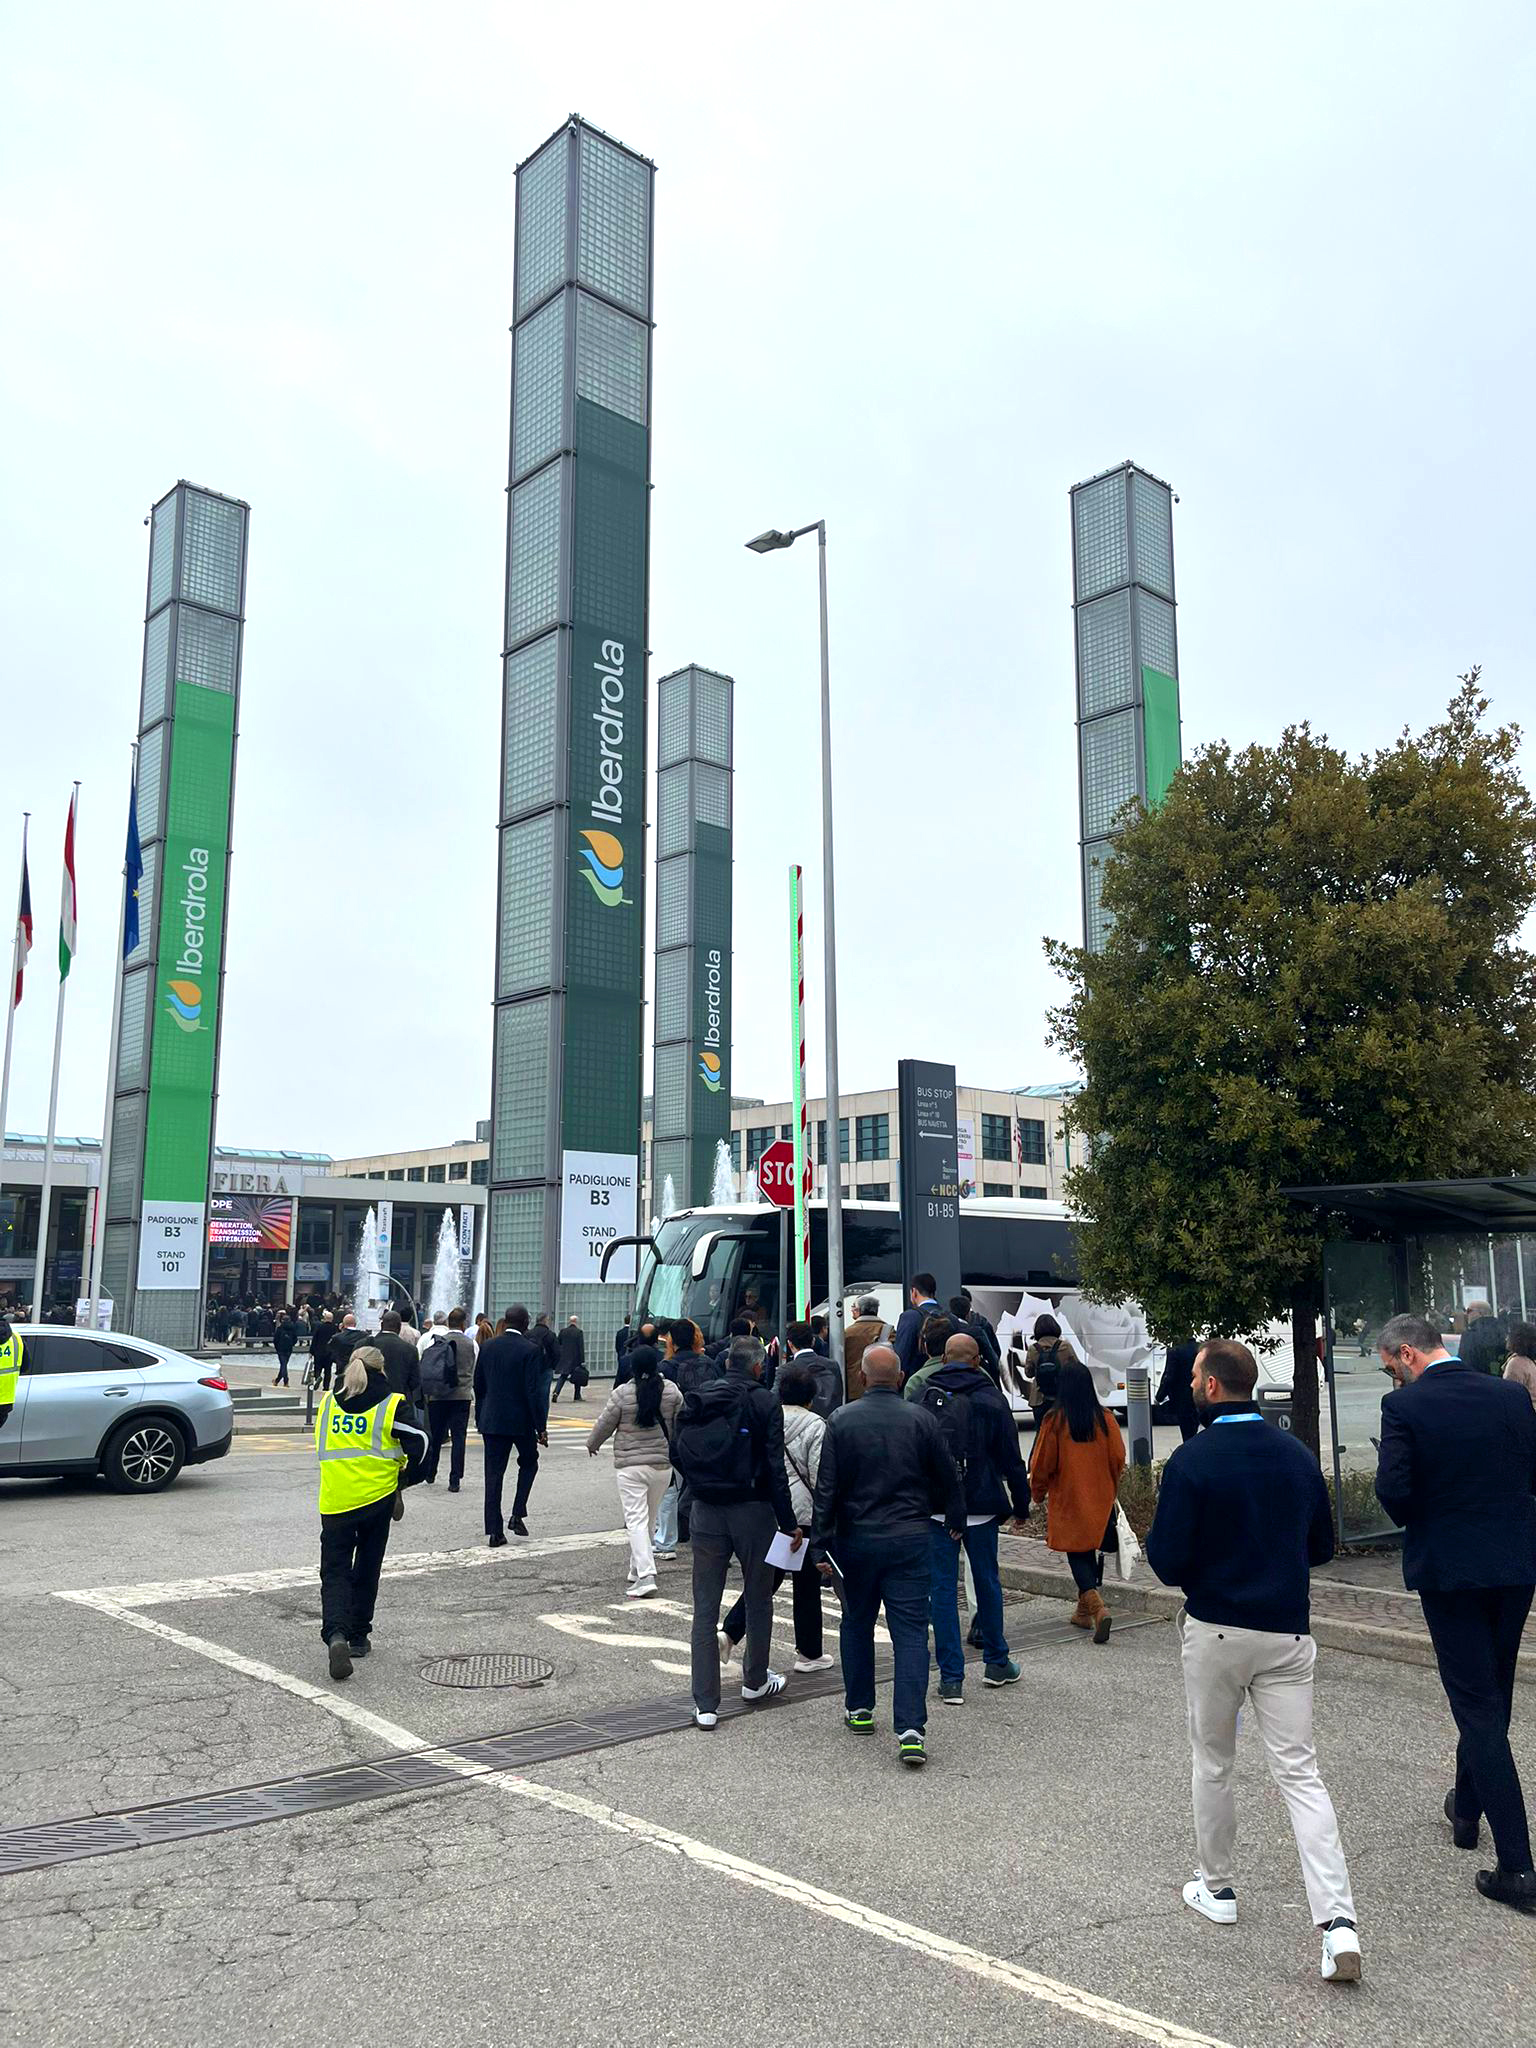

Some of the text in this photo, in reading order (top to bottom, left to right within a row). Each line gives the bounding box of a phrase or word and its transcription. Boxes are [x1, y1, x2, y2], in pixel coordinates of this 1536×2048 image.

[591, 638, 625, 824] Iberdrola
[176, 847, 209, 975] Iberdrola
[704, 949, 721, 1048] Iberdrola
[917, 1087, 953, 1100] BUS STOP
[569, 1173, 631, 1187] PADIGLIONE
[762, 1160, 810, 1187] STO
[214, 1172, 288, 1193] FIERA
[940, 1184, 957, 1197] NCC
[211, 1200, 233, 1209] DPE
[590, 1190, 610, 1206] B3
[928, 1202, 954, 1218] B1-B5
[147, 1215, 199, 1225] PADIGLIONE
[210, 1221, 254, 1229] GENERATION,
[164, 1226, 181, 1238] B3
[209, 1228, 263, 1237] TRANSMISSION,
[582, 1226, 617, 1237] STAND
[156, 1250, 186, 1259] STAND
[588, 1241, 607, 1257] 10
[161, 1261, 179, 1272] 101
[332, 1414, 367, 1434] 559
